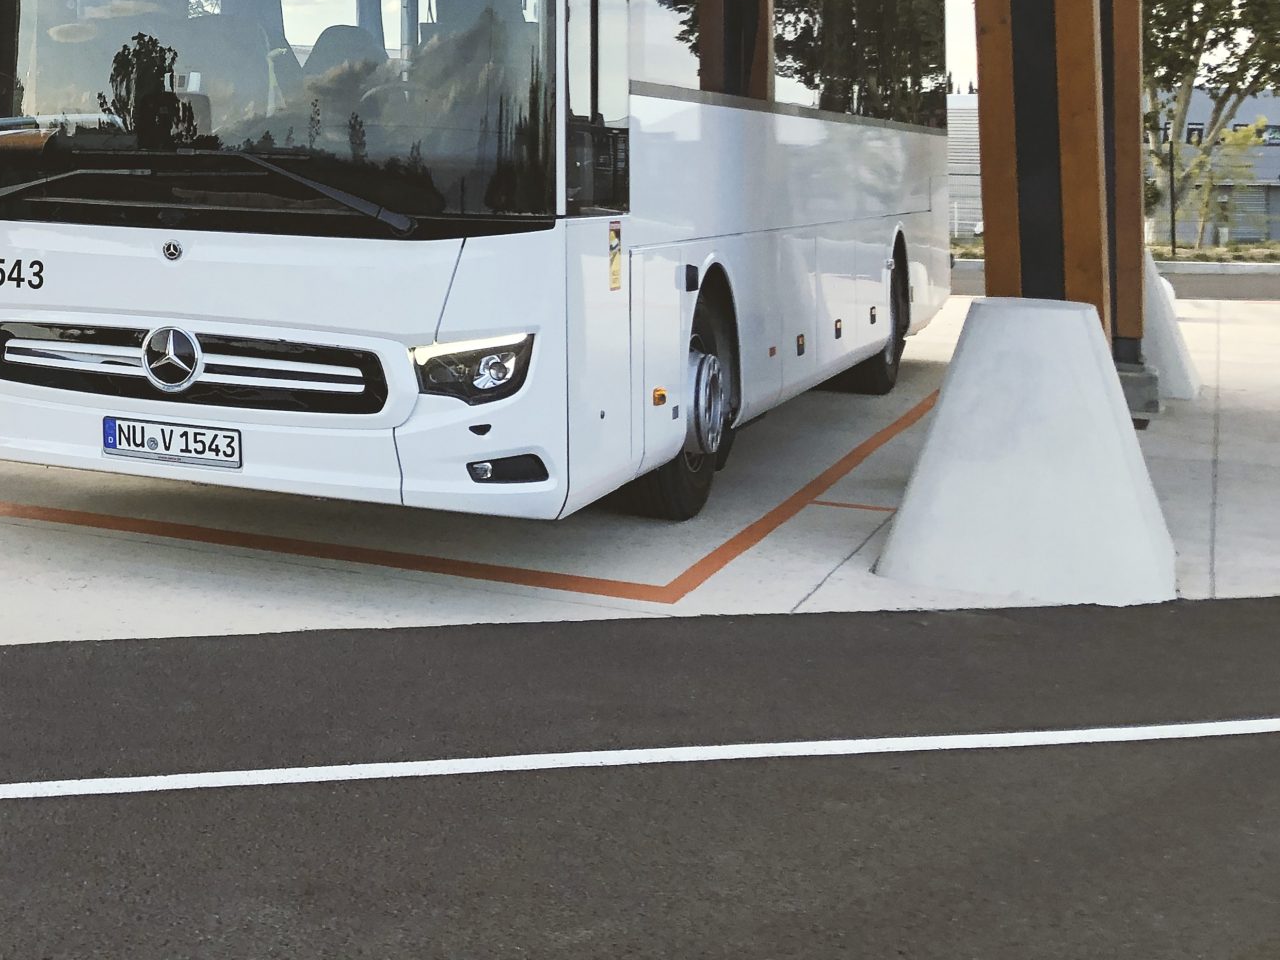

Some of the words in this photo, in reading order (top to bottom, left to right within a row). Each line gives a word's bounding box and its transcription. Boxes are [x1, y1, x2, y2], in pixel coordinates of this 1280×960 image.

[107, 436, 114, 444] D
[117, 423, 145, 448] NU
[160, 428, 174, 452] V
[179, 430, 236, 458] 1543
